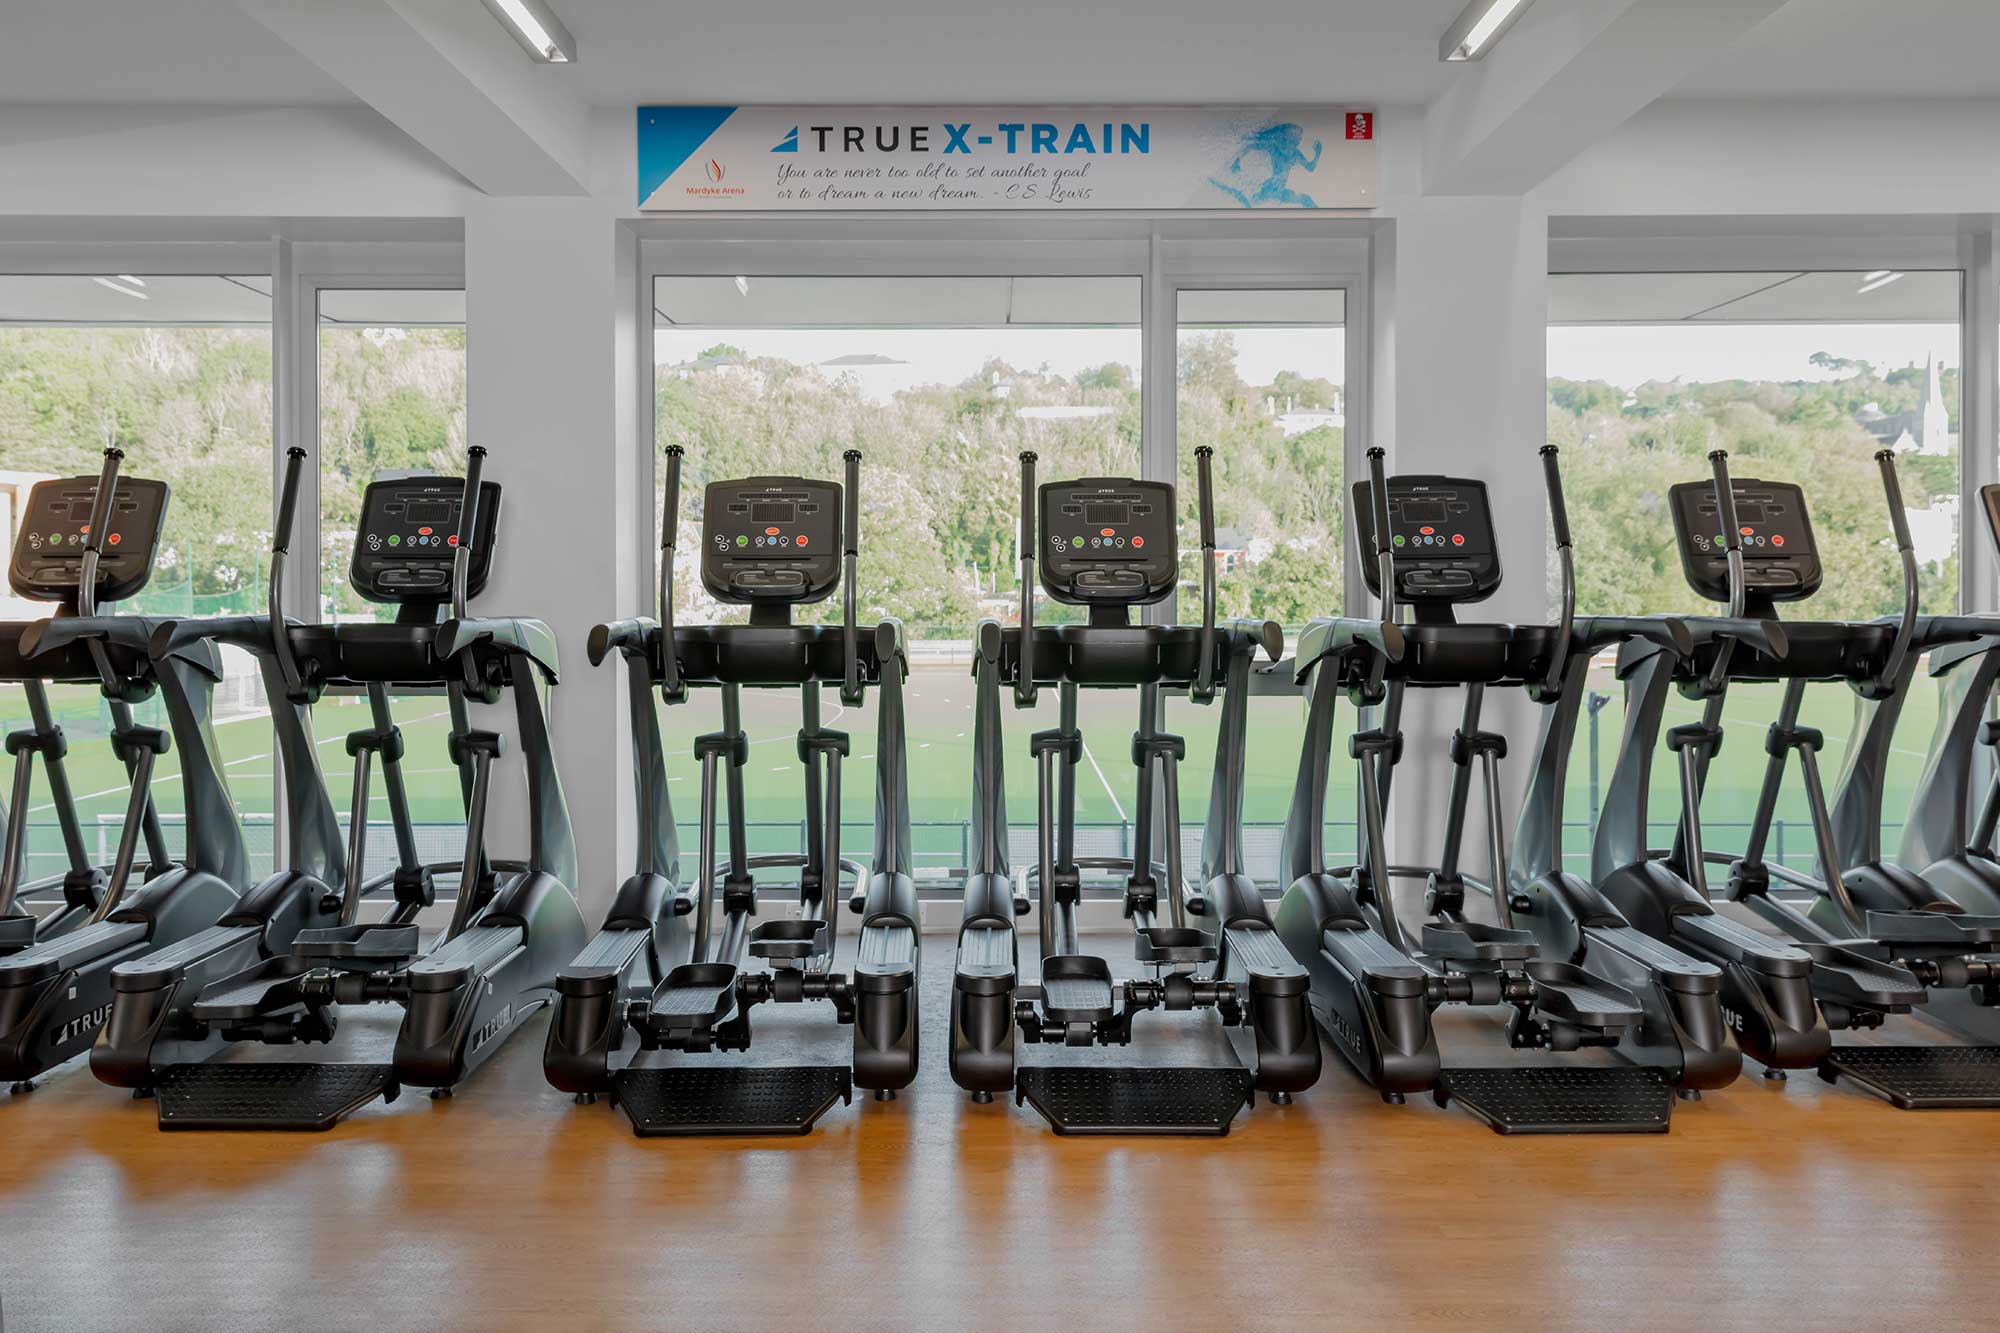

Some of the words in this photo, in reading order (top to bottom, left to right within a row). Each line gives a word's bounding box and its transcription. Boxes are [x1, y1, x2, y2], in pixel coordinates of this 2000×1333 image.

[810, 126, 929, 153] TRUE
[943, 123, 1150, 154] X-TRAIN
[777, 163, 807, 185] You
[813, 167, 838, 178] are
[843, 167, 881, 178] never
[888, 165, 909, 178] too
[916, 162, 945, 180] old
[945, 166, 959, 178] to
[966, 165, 985, 178] set
[990, 162, 1047, 178] another
[1053, 162, 1091, 188] goal
[686, 187, 720, 195] Mardyke
[777, 189, 793, 199] or
[799, 187, 811, 199] to
[818, 184, 867, 201] dream
[874, 190, 885, 199] a
[891, 189, 923, 199] new
[1047, 182, 1093, 203] Lewis
[1720, 1005, 1743, 1032] UE
